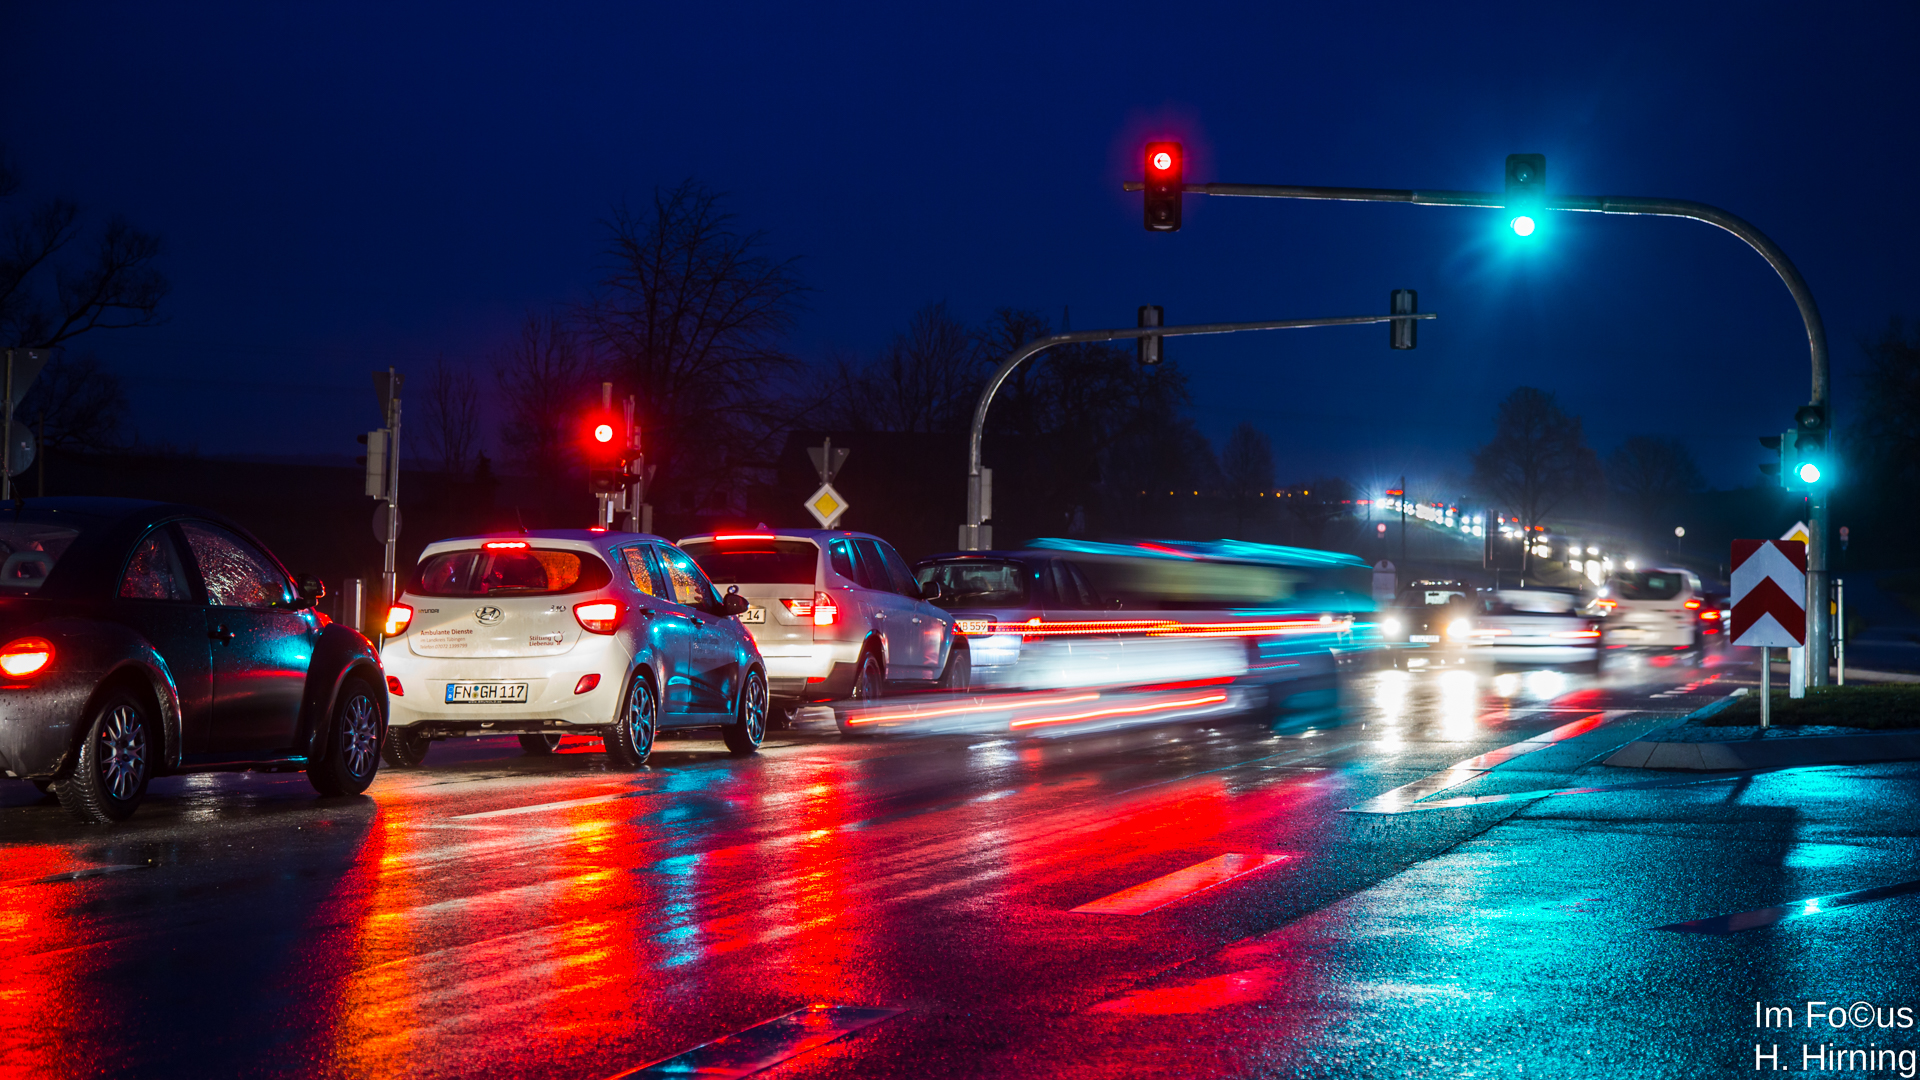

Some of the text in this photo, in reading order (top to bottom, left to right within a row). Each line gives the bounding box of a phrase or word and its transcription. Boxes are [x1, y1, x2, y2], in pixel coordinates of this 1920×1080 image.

[747, 610, 760, 620] 14
[970, 621, 987, 630] 559
[454, 686, 525, 698] FN GH 117
